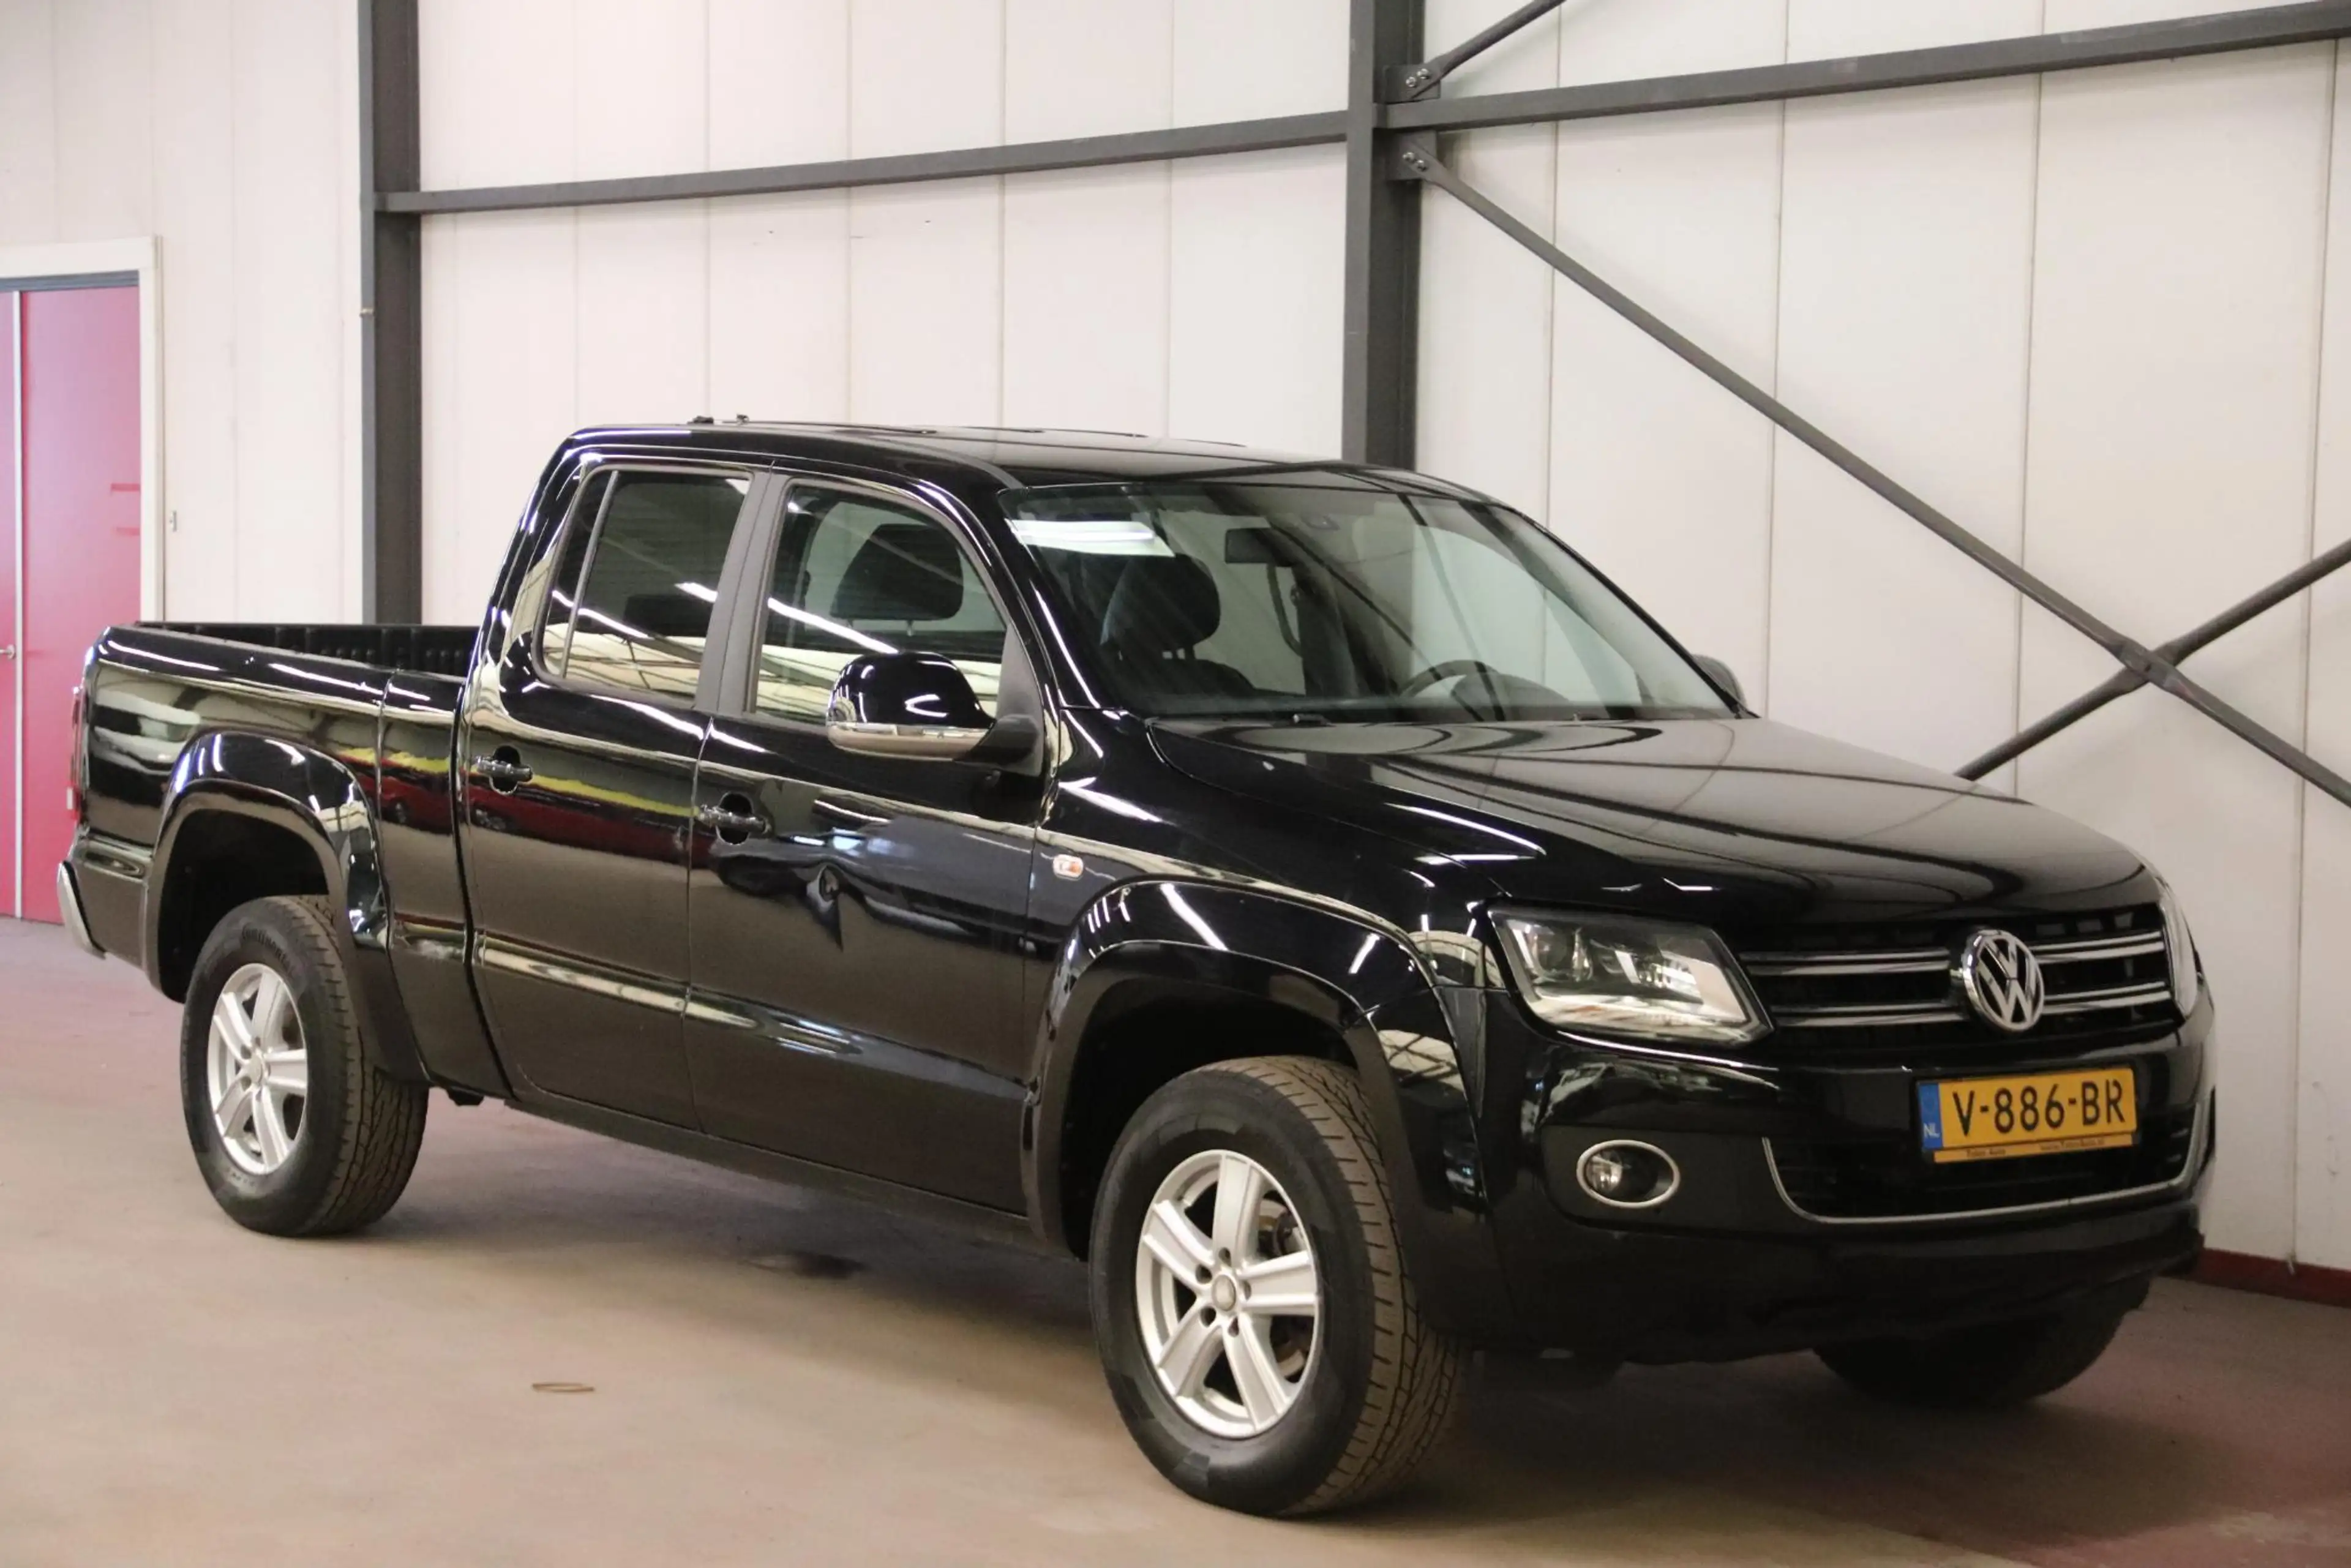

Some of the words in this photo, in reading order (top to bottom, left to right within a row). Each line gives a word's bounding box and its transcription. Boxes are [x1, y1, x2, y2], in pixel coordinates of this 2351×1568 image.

[1971, 932, 2044, 1029] VW
[1924, 1122, 1940, 1138] NL
[1952, 1079, 2126, 1137] V-886-BR
